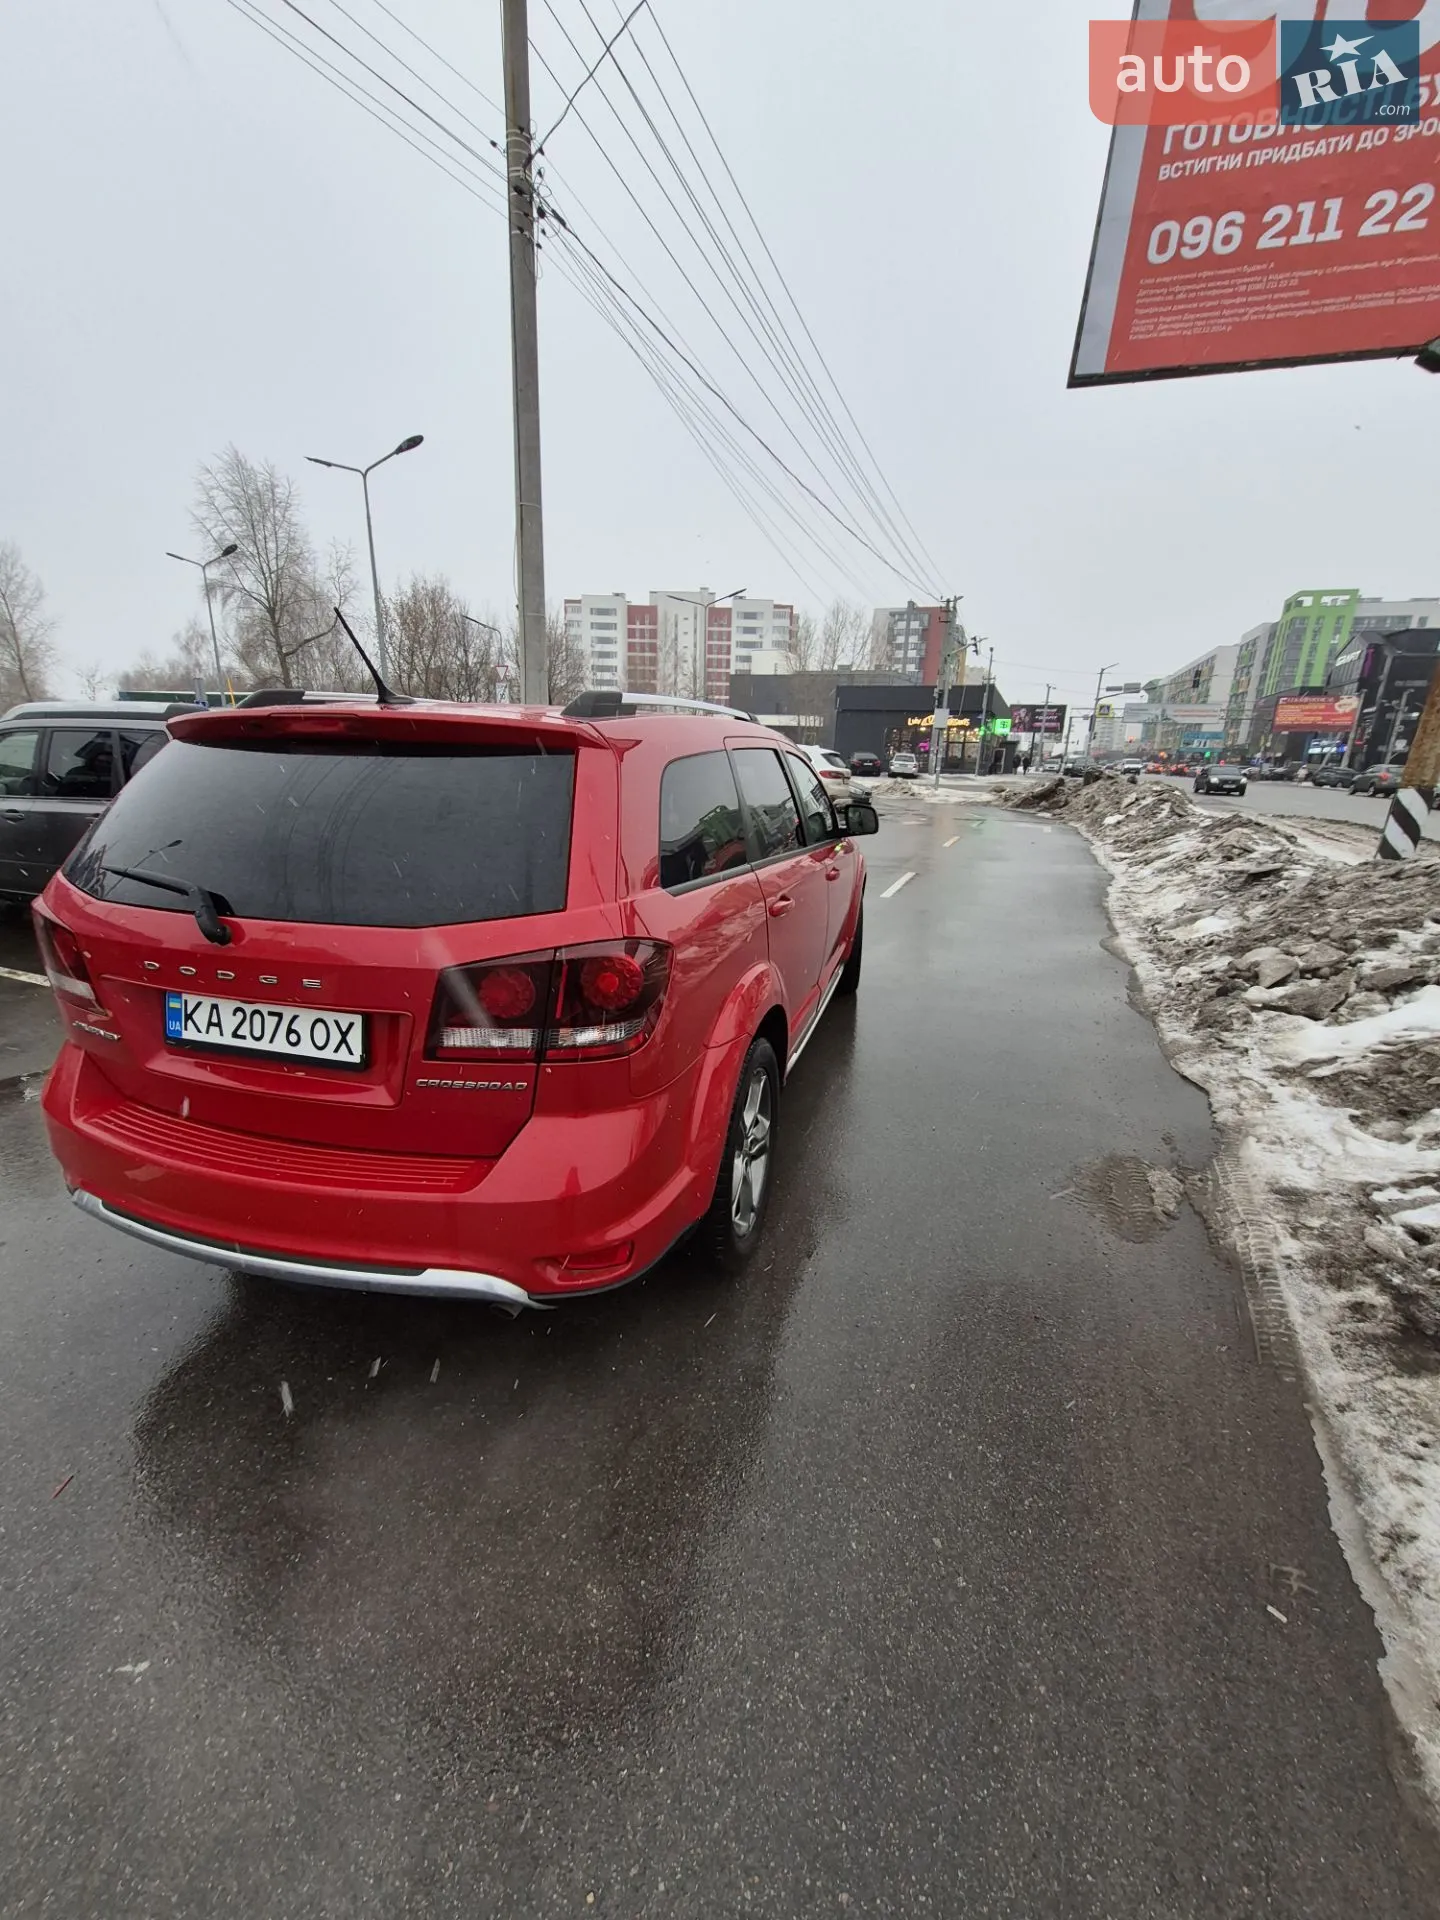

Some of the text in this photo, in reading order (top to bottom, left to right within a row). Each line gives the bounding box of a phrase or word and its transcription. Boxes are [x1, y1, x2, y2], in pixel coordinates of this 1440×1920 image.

[1158, 116, 1440, 181] ВСТИГНИ ПРИДБАТИ ДО ЗРО
[1146, 183, 1435, 265] 096 211 22
[143, 960, 322, 989] DODGE
[169, 999, 355, 1056] UA KA 2076 OX
[416, 1078, 528, 1091] CROSSROAD
